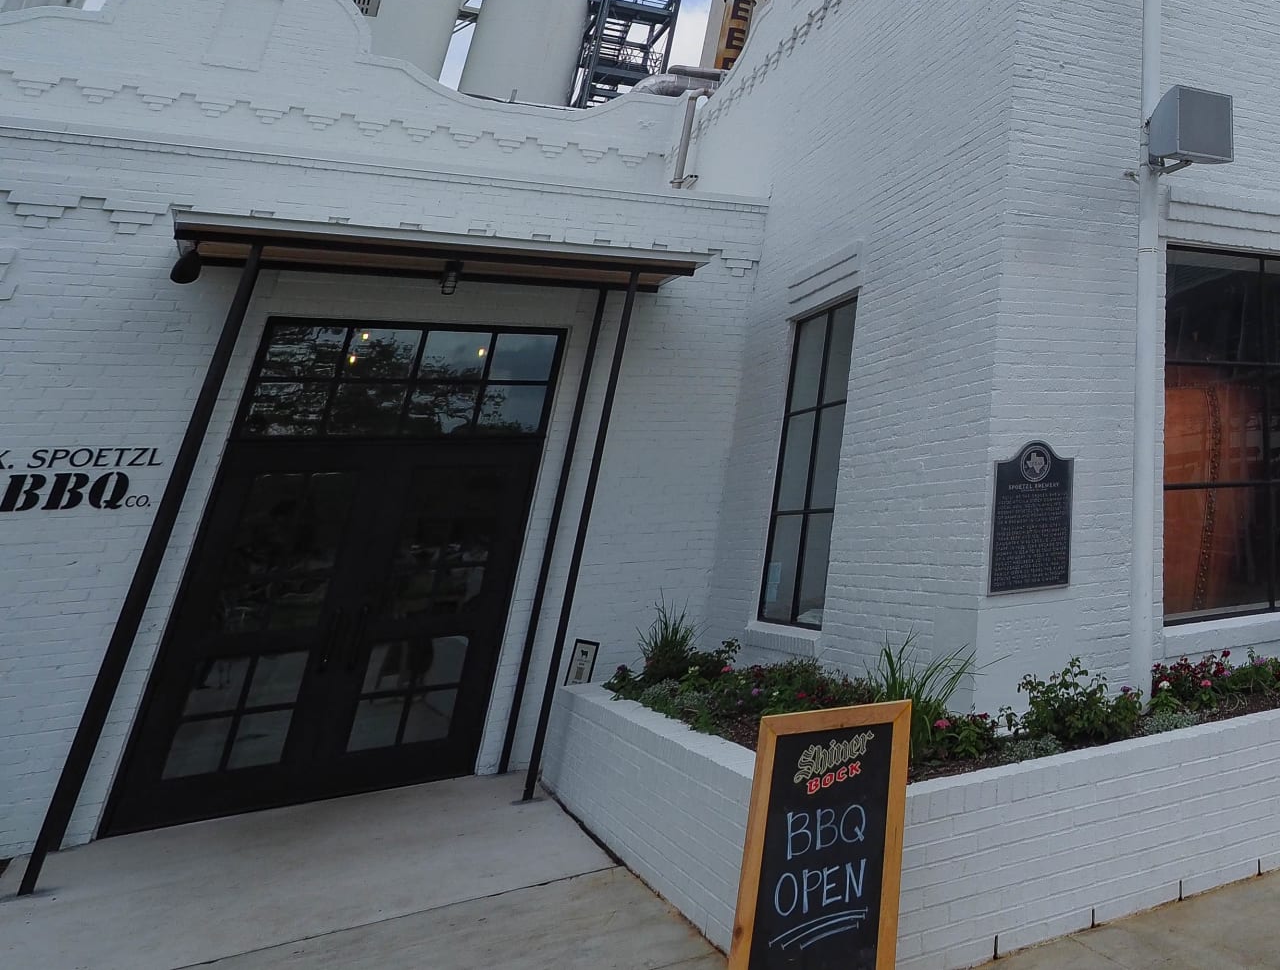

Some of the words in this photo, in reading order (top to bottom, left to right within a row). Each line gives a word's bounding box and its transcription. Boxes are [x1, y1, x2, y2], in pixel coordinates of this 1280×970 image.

[27, 448, 163, 469] SPOETZL
[0, 471, 130, 512] BBQ
[125, 495, 151, 508] CO.
[992, 632, 1059, 655] BREERY
[793, 730, 875, 784] Shiner
[806, 760, 862, 795] BOCK
[786, 804, 867, 861] BBQ
[774, 857, 867, 917] OPEN
